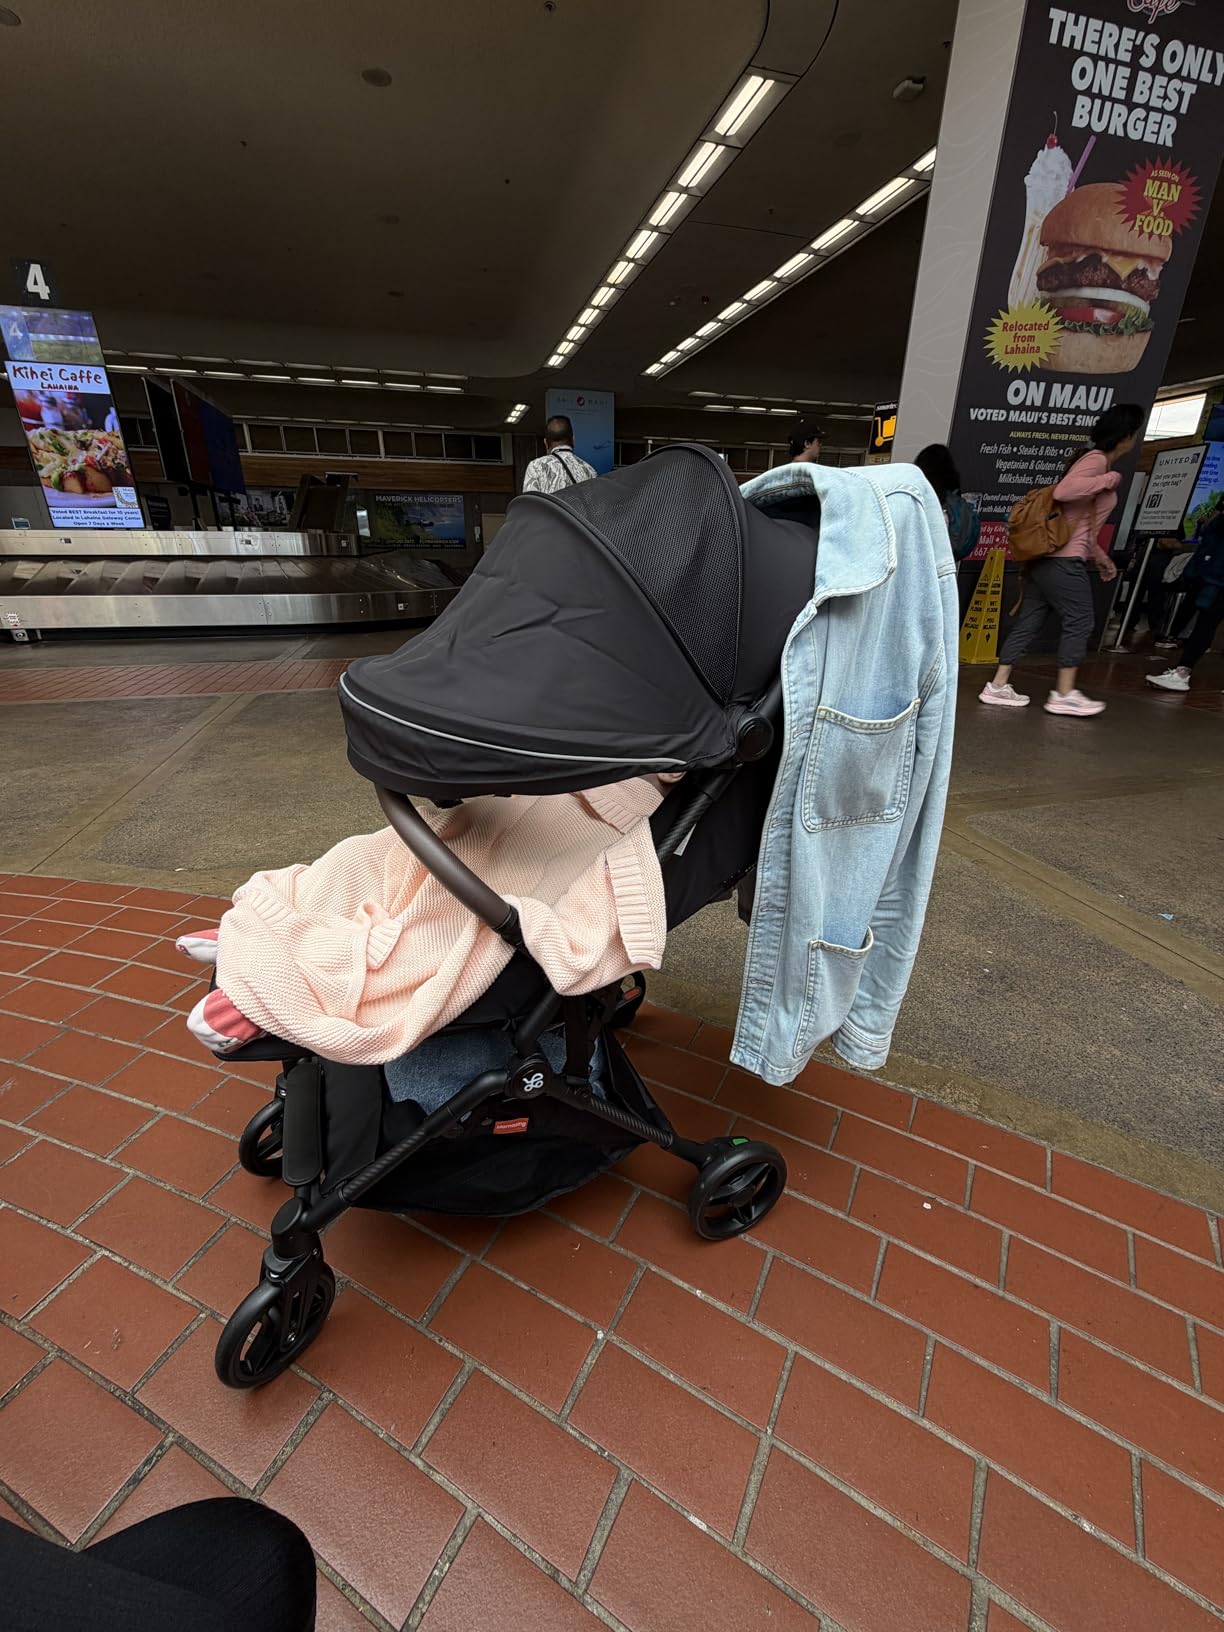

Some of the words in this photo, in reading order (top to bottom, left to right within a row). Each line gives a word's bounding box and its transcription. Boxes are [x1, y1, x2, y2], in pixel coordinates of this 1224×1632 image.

[1049, 7, 1160, 68] THERE'S
[1162, 39, 1224, 86] ONLY
[1071, 55, 1131, 100] ONE
[1132, 70, 1197, 114] BEST
[1071, 94, 1177, 147] BURGER
[1158, 170, 1171, 179] SEEN
[1171, 173, 1180, 183] ON
[1143, 178, 1182, 202] MAN
[1134, 214, 1174, 236] FOOD
[26, 263, 51, 300] 4
[9, 321, 23, 339] 4
[1002, 320, 1050, 332] Relocated
[1012, 332, 1036, 343] from
[1004, 344, 1041, 355] Lahaina
[12, 365, 53, 381] Kihei
[58, 368, 102, 384] Caffe
[40, 382, 79, 391] LAHAINA
[1006, 380, 1046, 407] ON
[969, 407, 1007, 422] VOTED
[1008, 410, 1048, 424] MAUI'S
[1049, 412, 1075, 426] BEST
[1009, 431, 1032, 439] ALWAYS
[1050, 433, 1069, 441] NEVER
[980, 443, 998, 454] Fresh
[998, 444, 1012, 454] Fish
[1018, 444, 1038, 456] Steaks
[1038, 446, 1044, 456] &
[1044, 446, 1058, 457] Ribs
[996, 458, 1028, 472] Vegetarian
[1029, 460, 1034, 470] &
[1035, 460, 1056, 471] Gluten
[1159, 456, 1190, 466] UNITED
[1034, 474, 1052, 485] Floats
[414, 495, 463, 503] HELICOPTERS
[982, 493, 1001, 501] Owned
[978, 534, 994, 544] Mall
